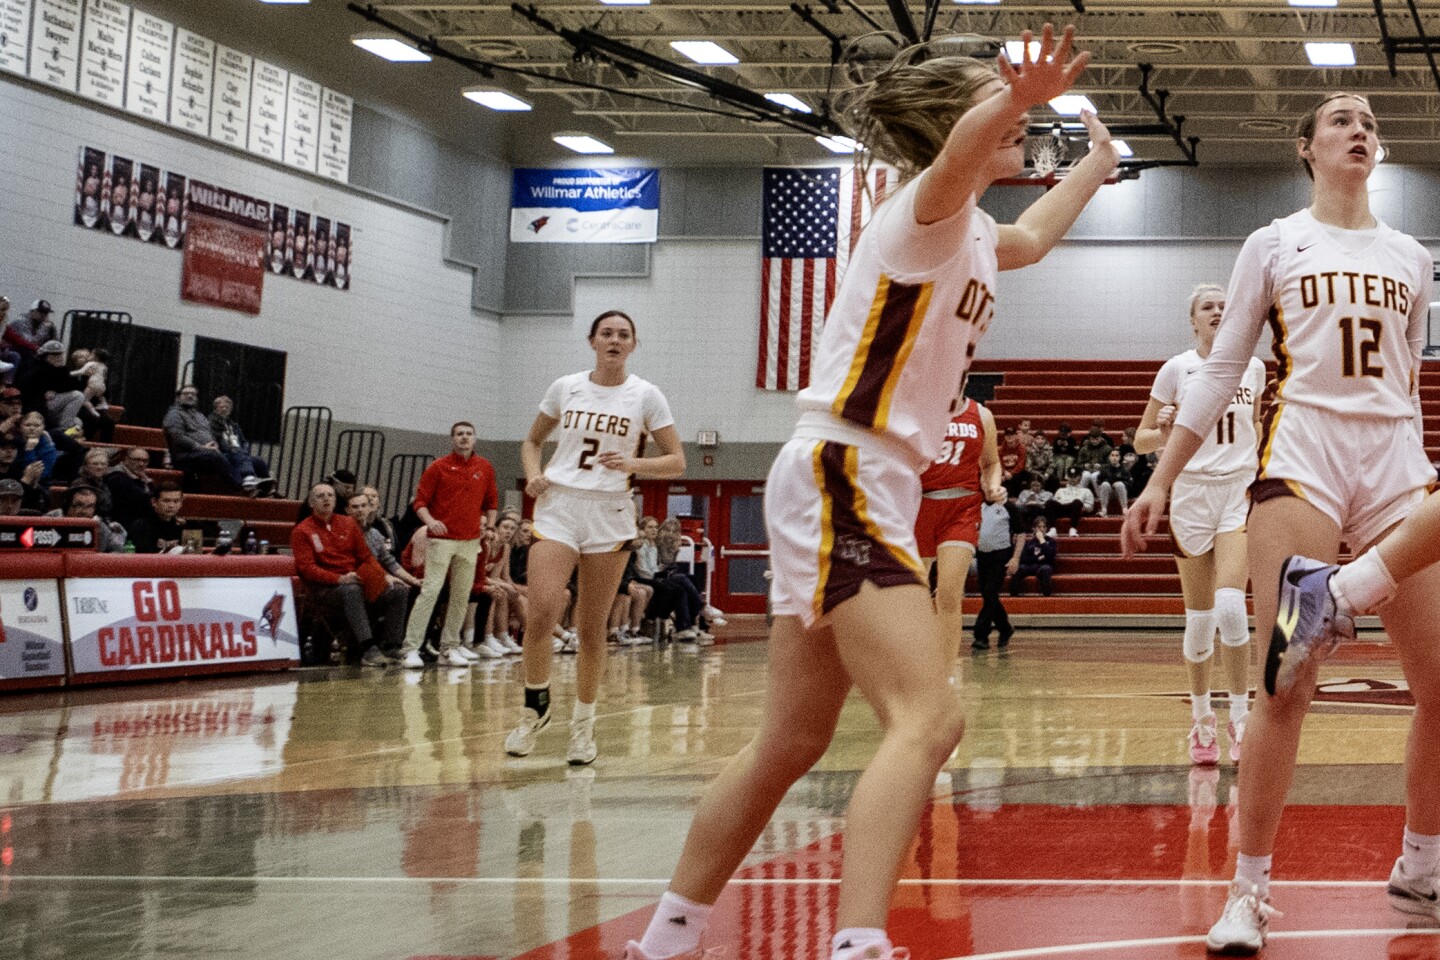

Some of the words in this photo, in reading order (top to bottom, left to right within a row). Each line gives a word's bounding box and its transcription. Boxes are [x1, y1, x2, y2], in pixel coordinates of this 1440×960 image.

[190, 185, 268, 222] WILLMAR
[531, 186, 582, 199] Willmar
[583, 186, 642, 200] Athletics
[1300, 271, 1410, 317] OTTERS
[1339, 317, 1384, 378] 12
[564, 410, 631, 437] OTTERS
[578, 437, 600, 470] 2
[132, 581, 182, 622] GO
[98, 621, 258, 667] CARDINALS
